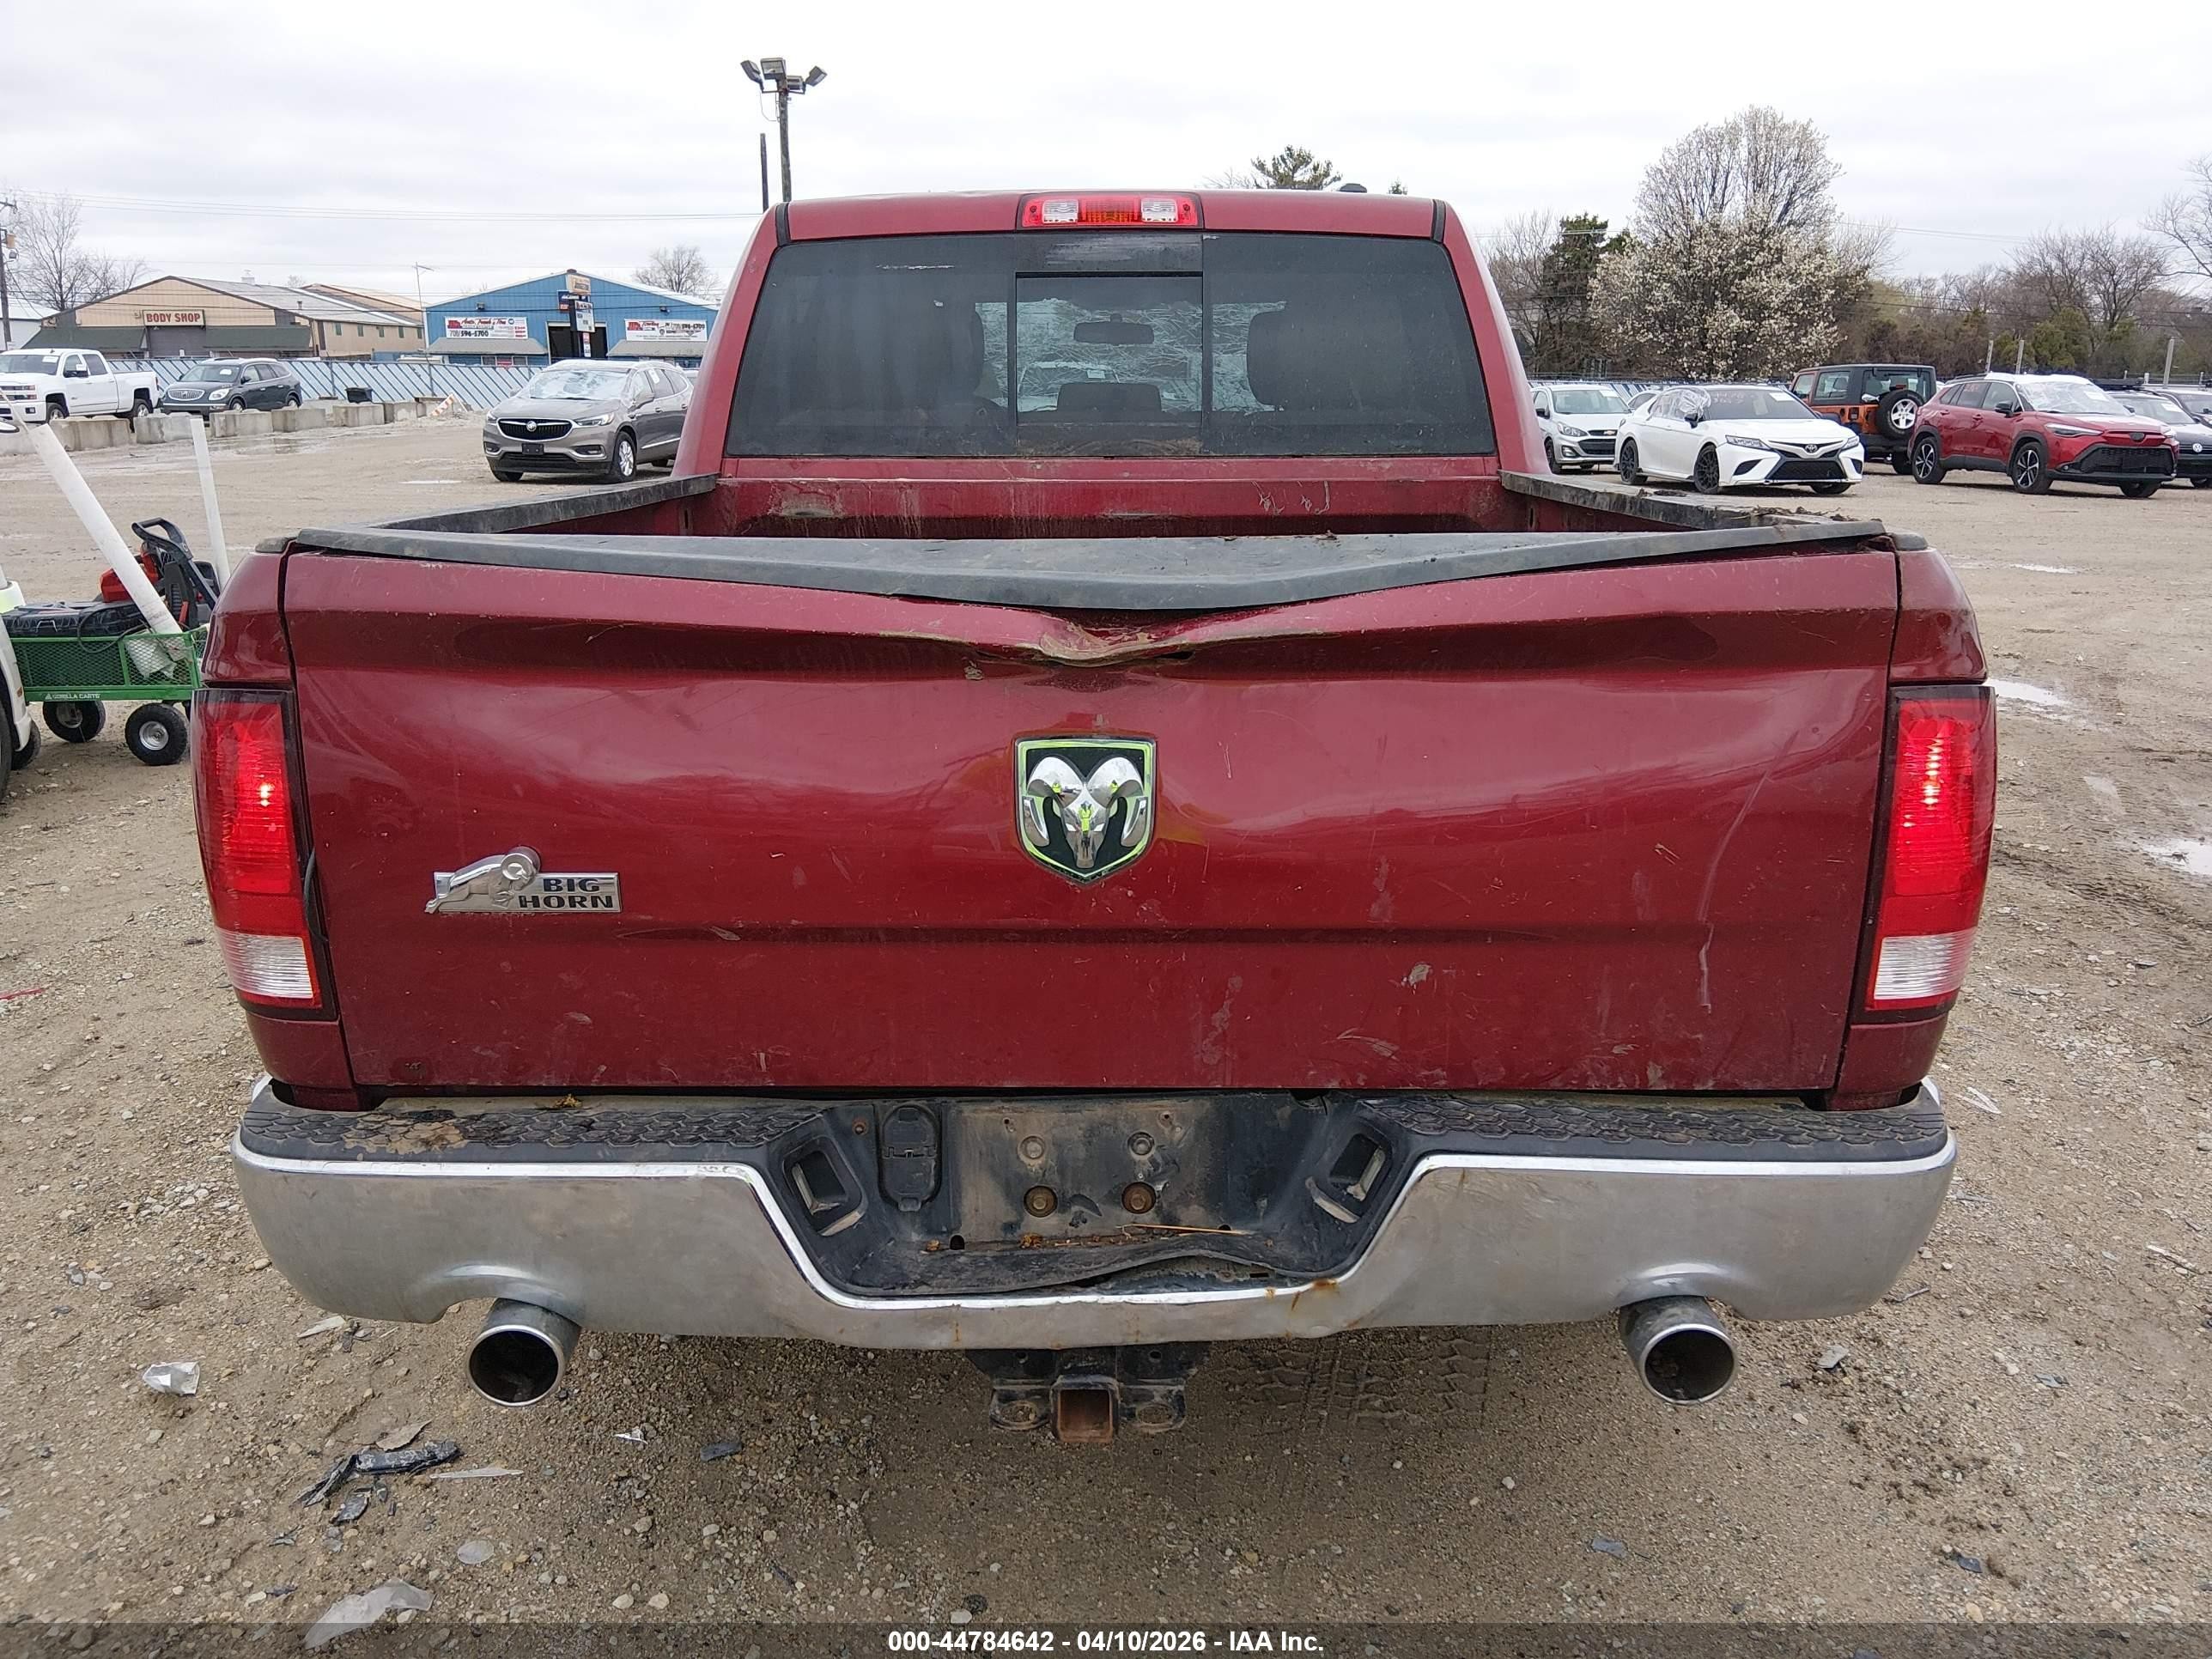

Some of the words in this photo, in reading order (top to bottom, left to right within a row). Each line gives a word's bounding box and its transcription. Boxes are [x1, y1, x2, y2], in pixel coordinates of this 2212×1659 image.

[146, 313, 172, 323] BODY
[174, 313, 201, 323] SHOP
[543, 878, 600, 892] BIG
[518, 894, 613, 909] HORN
